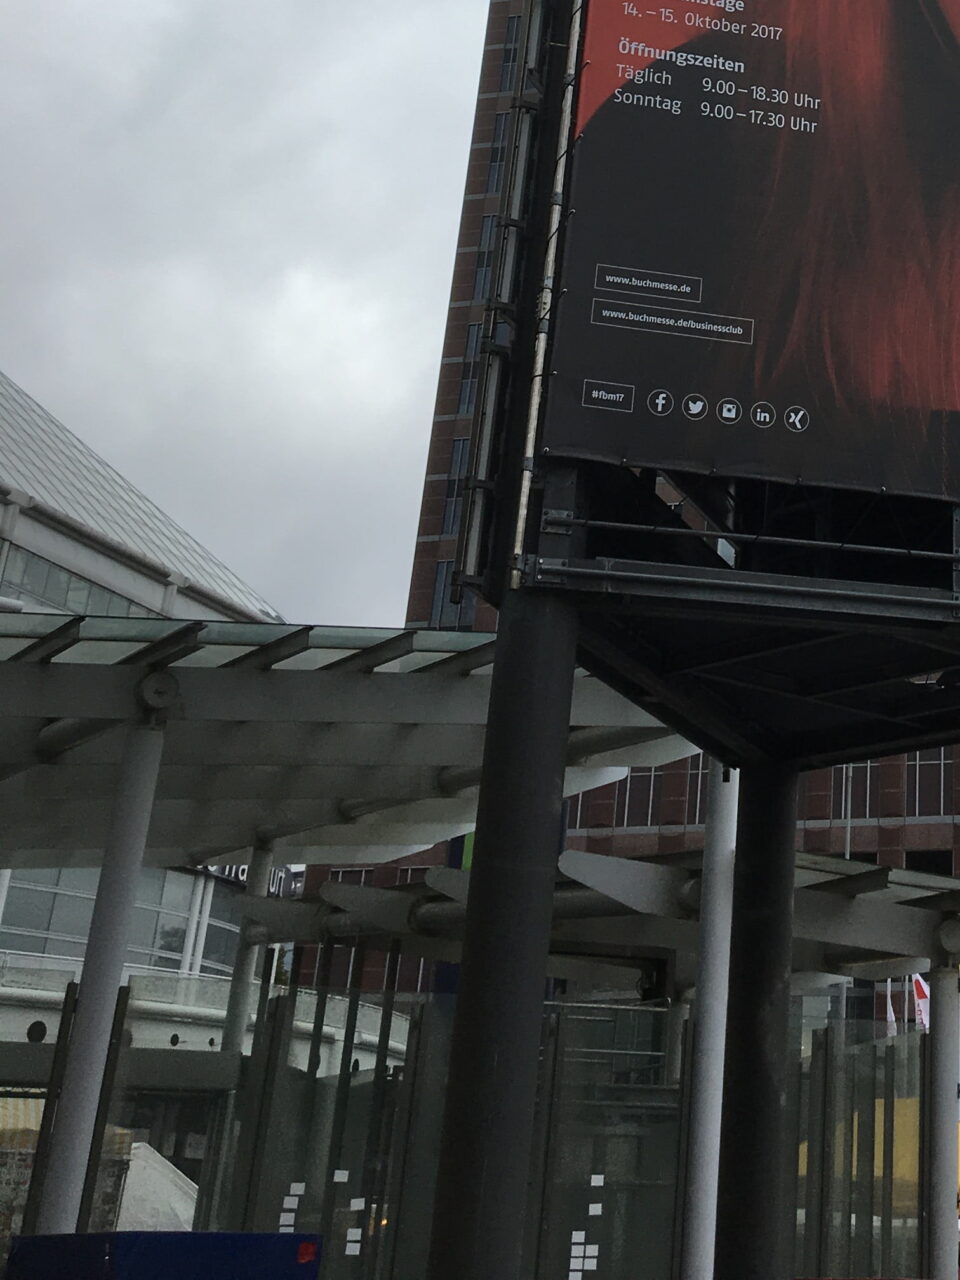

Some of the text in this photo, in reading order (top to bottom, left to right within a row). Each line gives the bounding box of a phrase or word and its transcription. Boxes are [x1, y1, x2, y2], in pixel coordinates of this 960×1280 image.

[684, 12, 747, 35] Oktober
[750, 23, 783, 41] 2017
[618, 37, 746, 73] Öffnungszeiten
[616, 63, 672, 86] Täglich
[793, 92, 821, 110] Uhr
[613, 88, 683, 115] Sonntag
[790, 116, 818, 133] Uhr
[605, 273, 692, 294] www.buchmesse.de
[602, 308, 744, 336] www.buchmesse.de/businessclub
[591, 389, 625, 403] #fbm17
